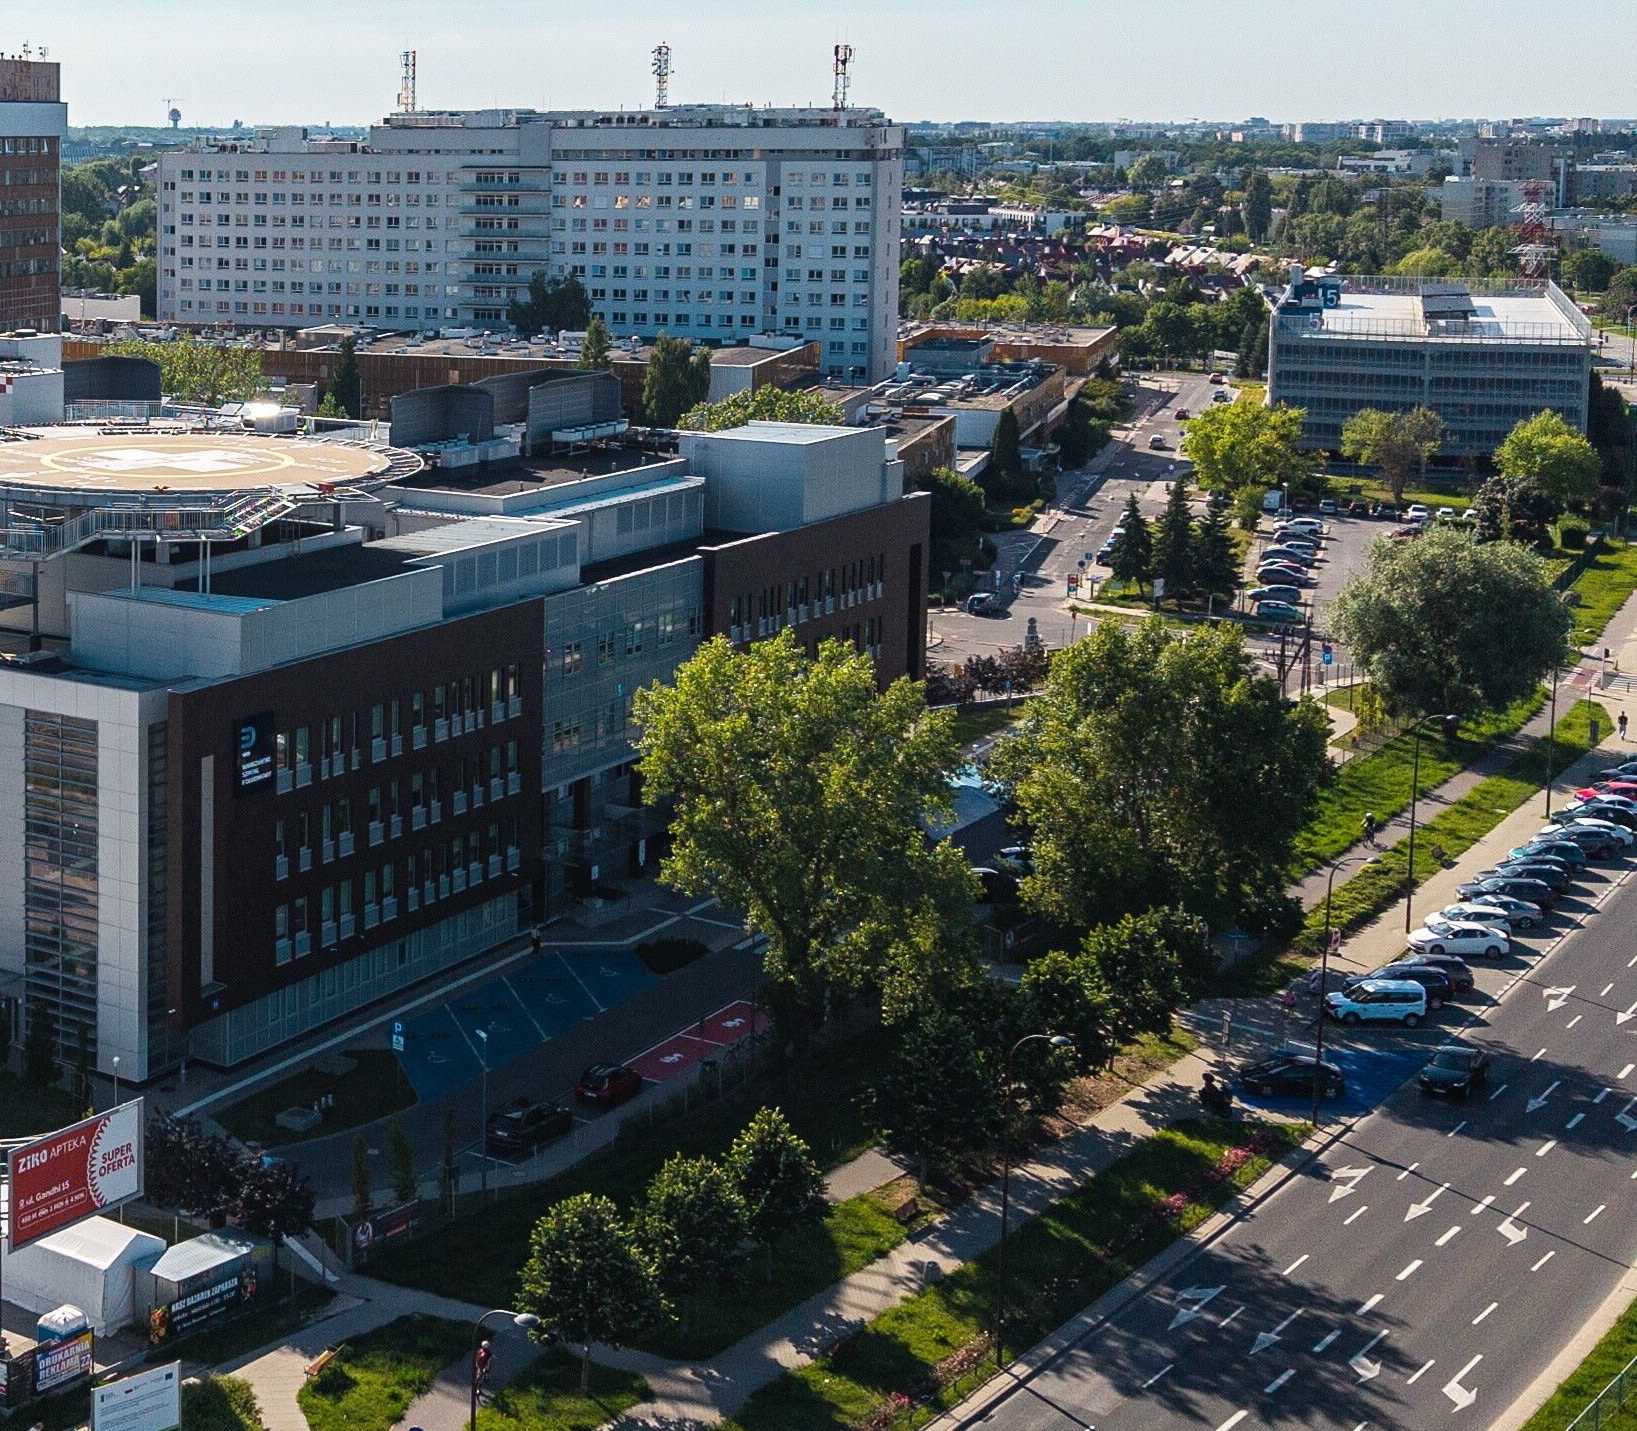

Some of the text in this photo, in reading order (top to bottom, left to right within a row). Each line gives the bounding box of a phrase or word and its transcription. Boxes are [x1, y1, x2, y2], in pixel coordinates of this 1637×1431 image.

[50, 1136, 86, 1160] APTEKA
[102, 1143, 132, 1164] SUPER
[99, 1155, 135, 1176] OFERTA
[36, 1185, 61, 1202] Gandhi
[39, 1341, 89, 1369] DRUKARNIA
[39, 1355, 80, 1380] REKLAMA
